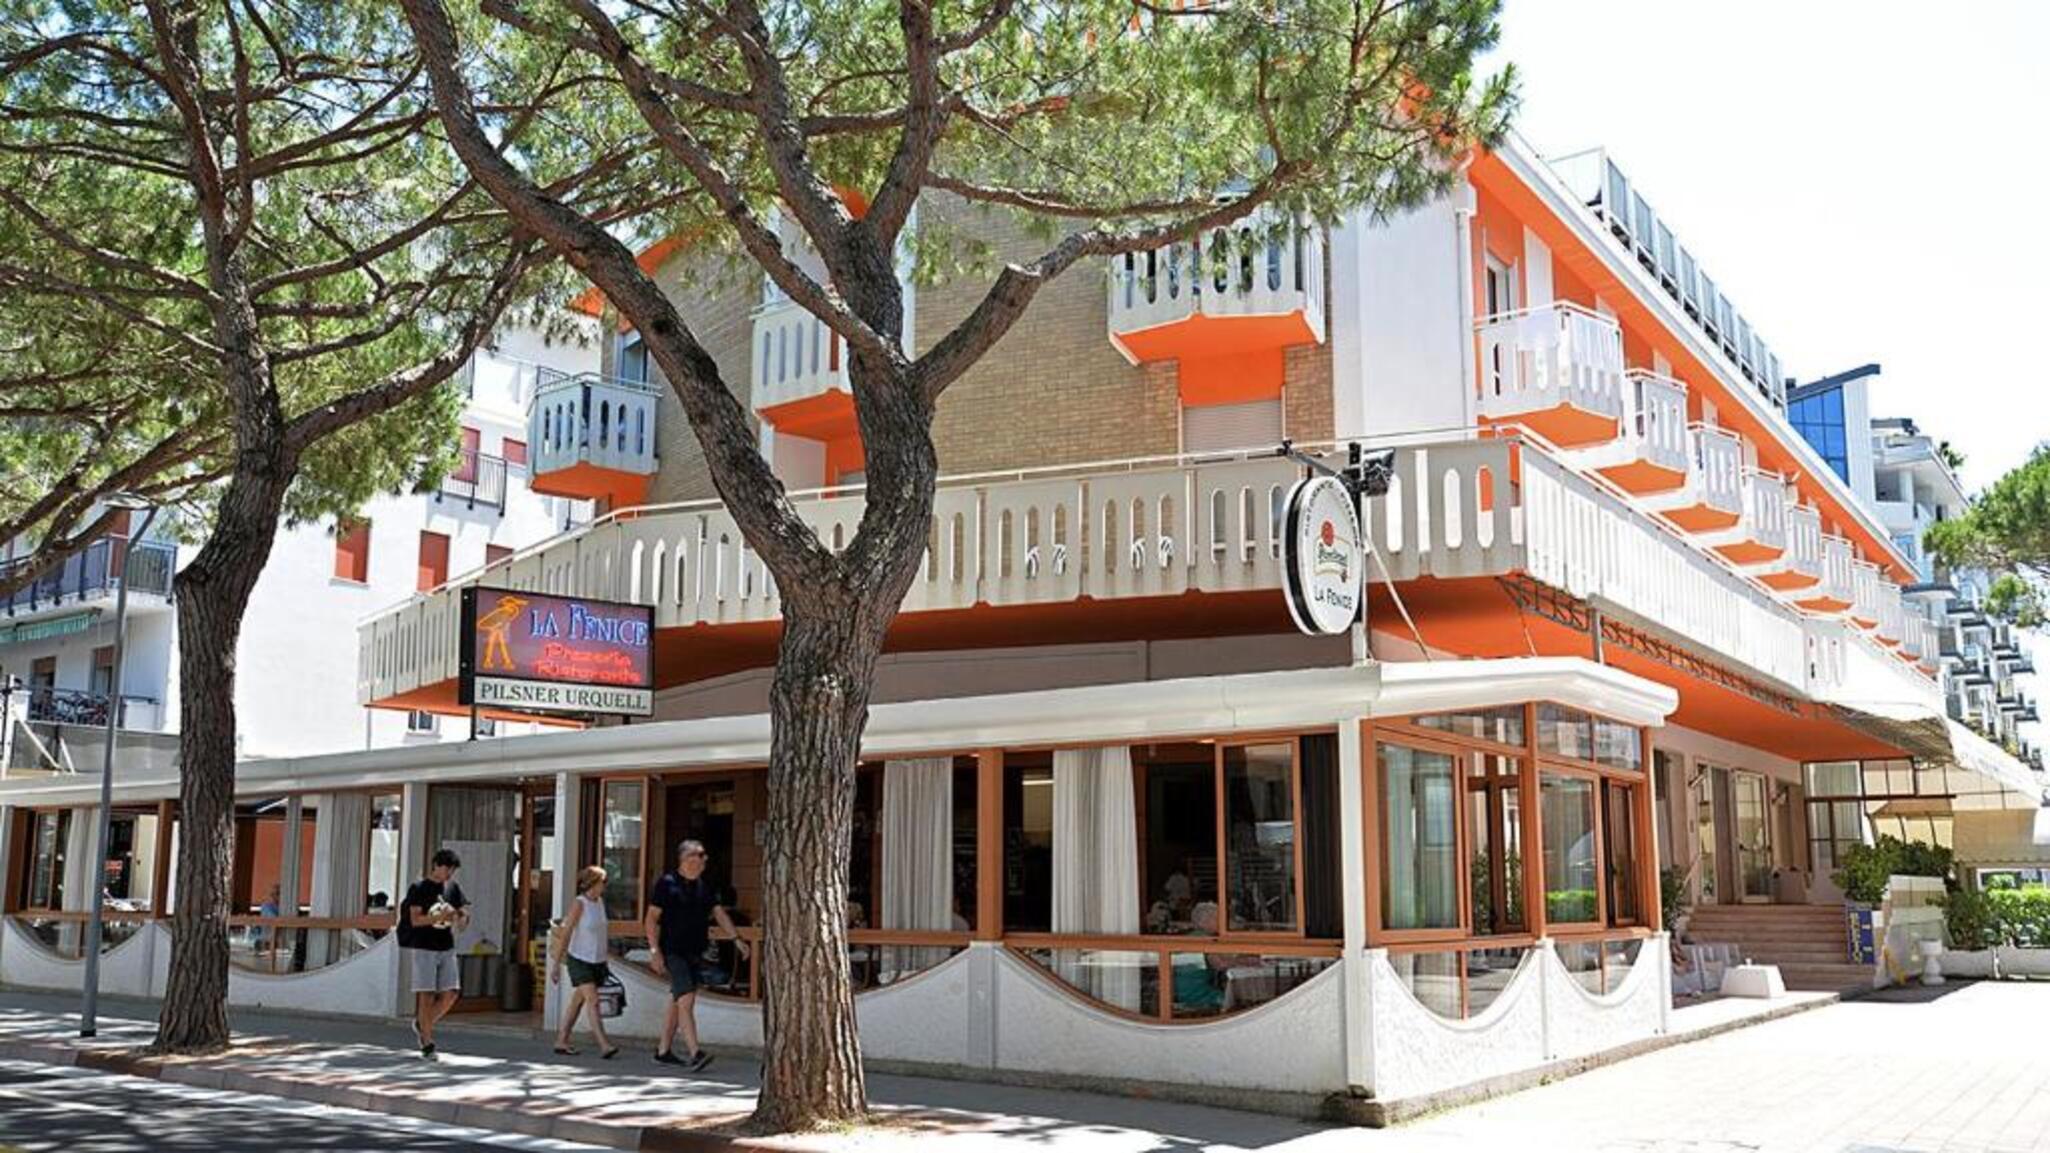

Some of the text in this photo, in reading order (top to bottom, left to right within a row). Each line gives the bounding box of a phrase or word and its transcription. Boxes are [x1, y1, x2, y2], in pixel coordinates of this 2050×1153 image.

[530, 603, 648, 645] LA FENICE
[481, 682, 648, 710] PILSNER URQUELL
